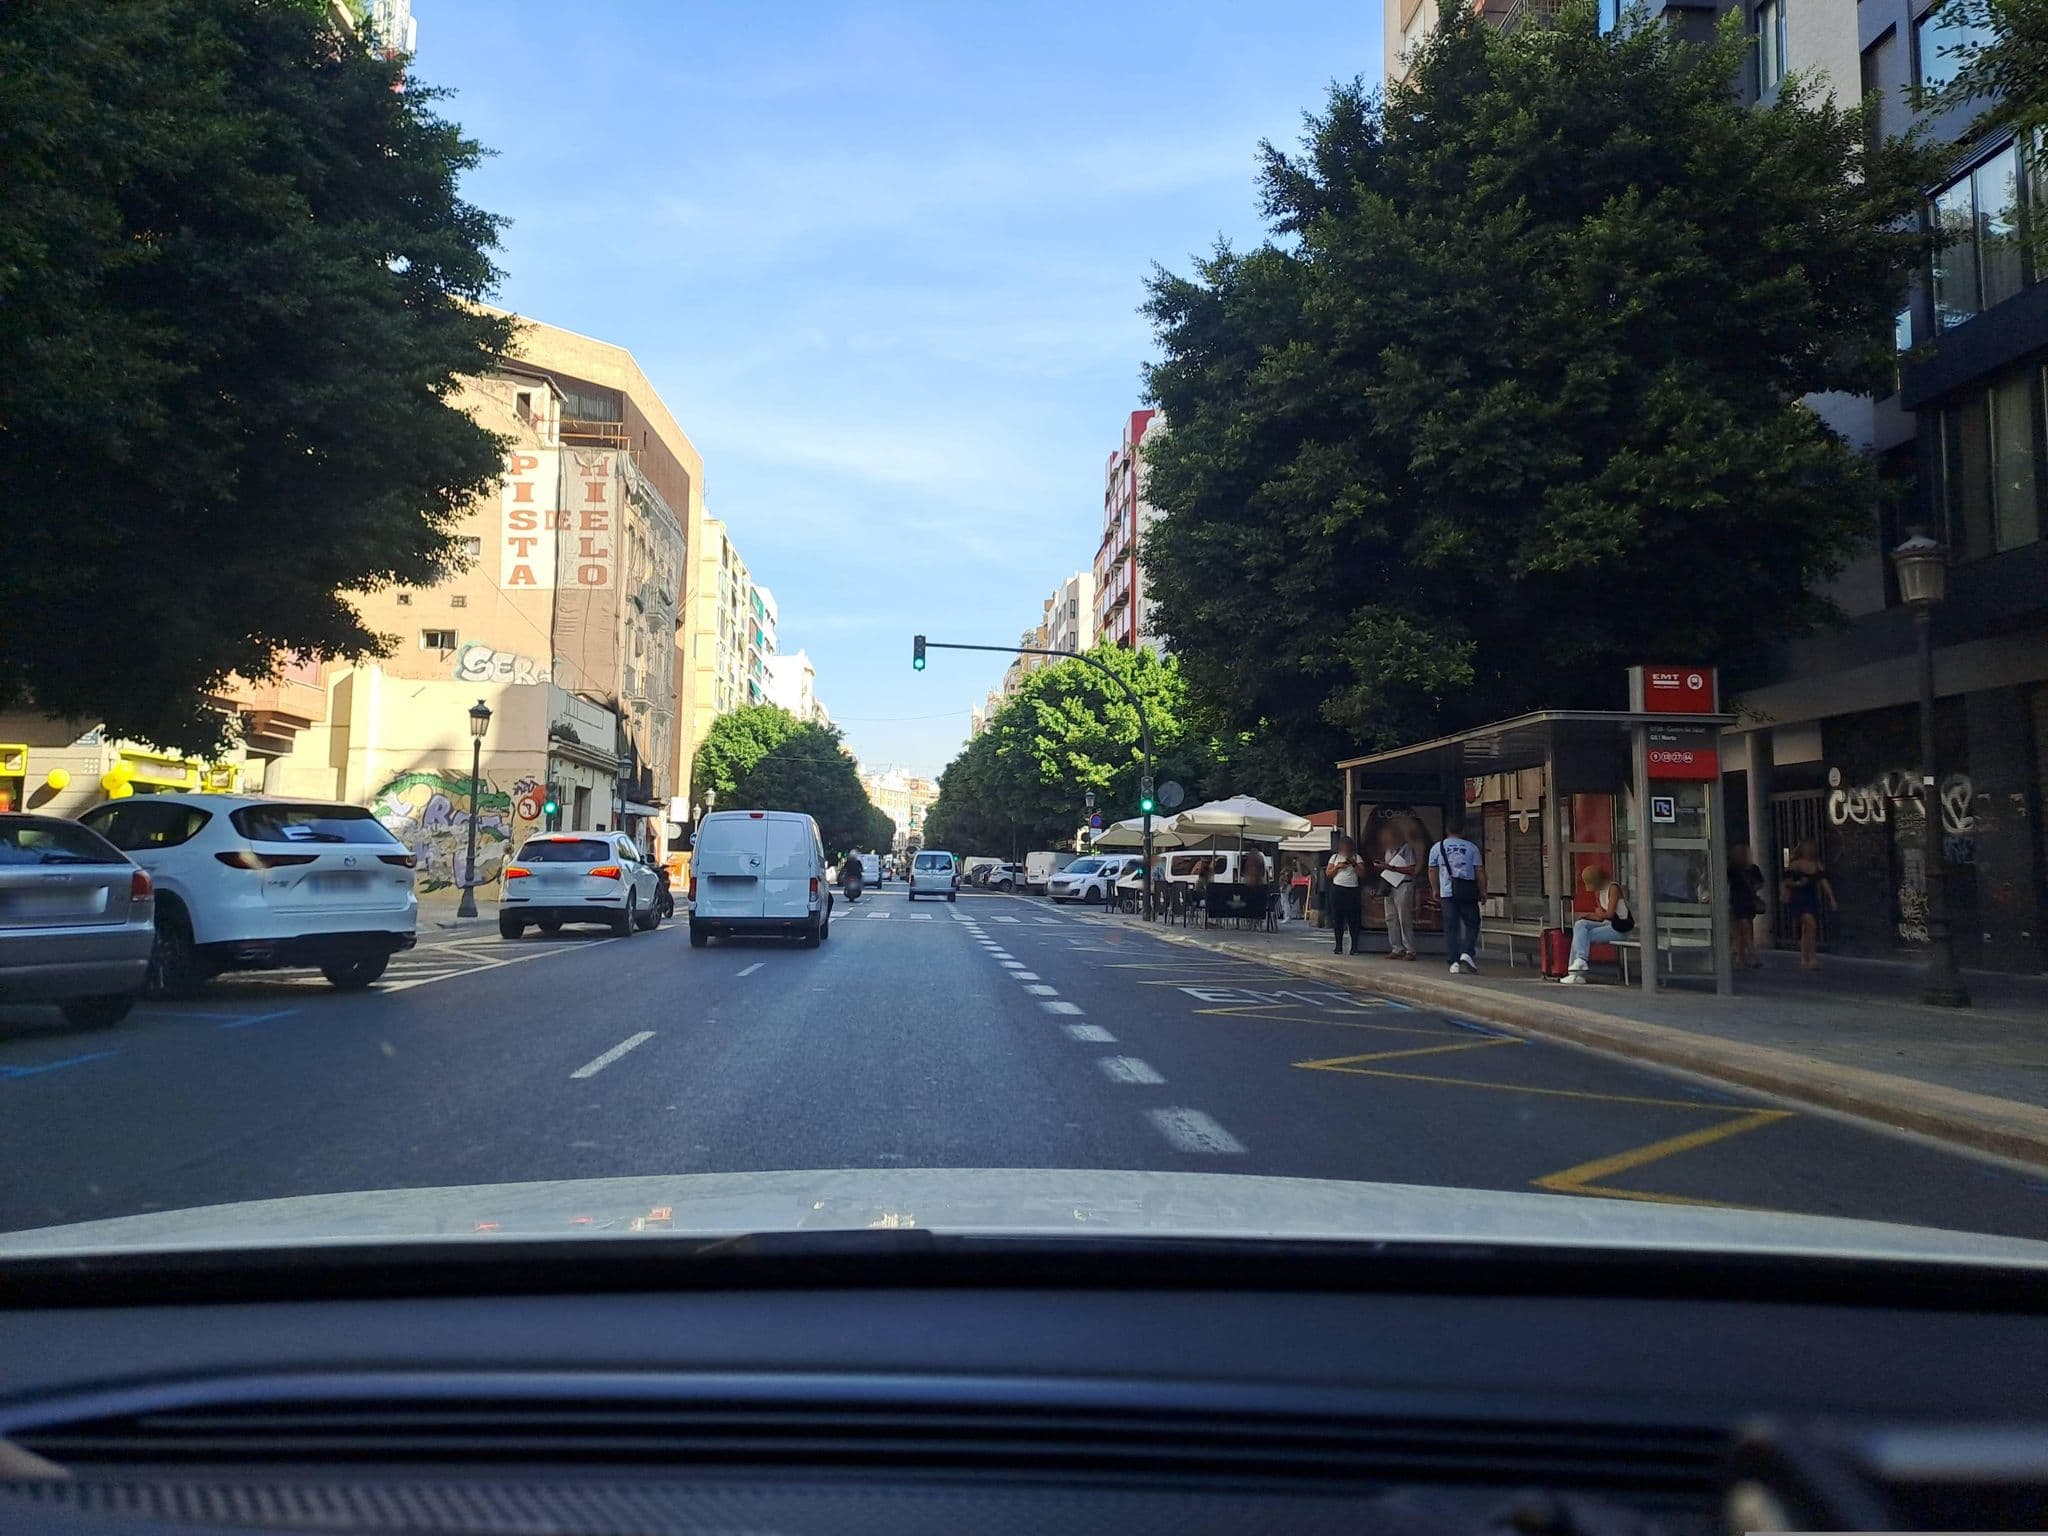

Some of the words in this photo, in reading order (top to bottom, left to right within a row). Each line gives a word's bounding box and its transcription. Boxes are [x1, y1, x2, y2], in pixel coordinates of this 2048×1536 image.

[508, 455, 538, 585] PISTA
[544, 510, 572, 531] DE
[1177, 986, 1369, 1007] EMT
